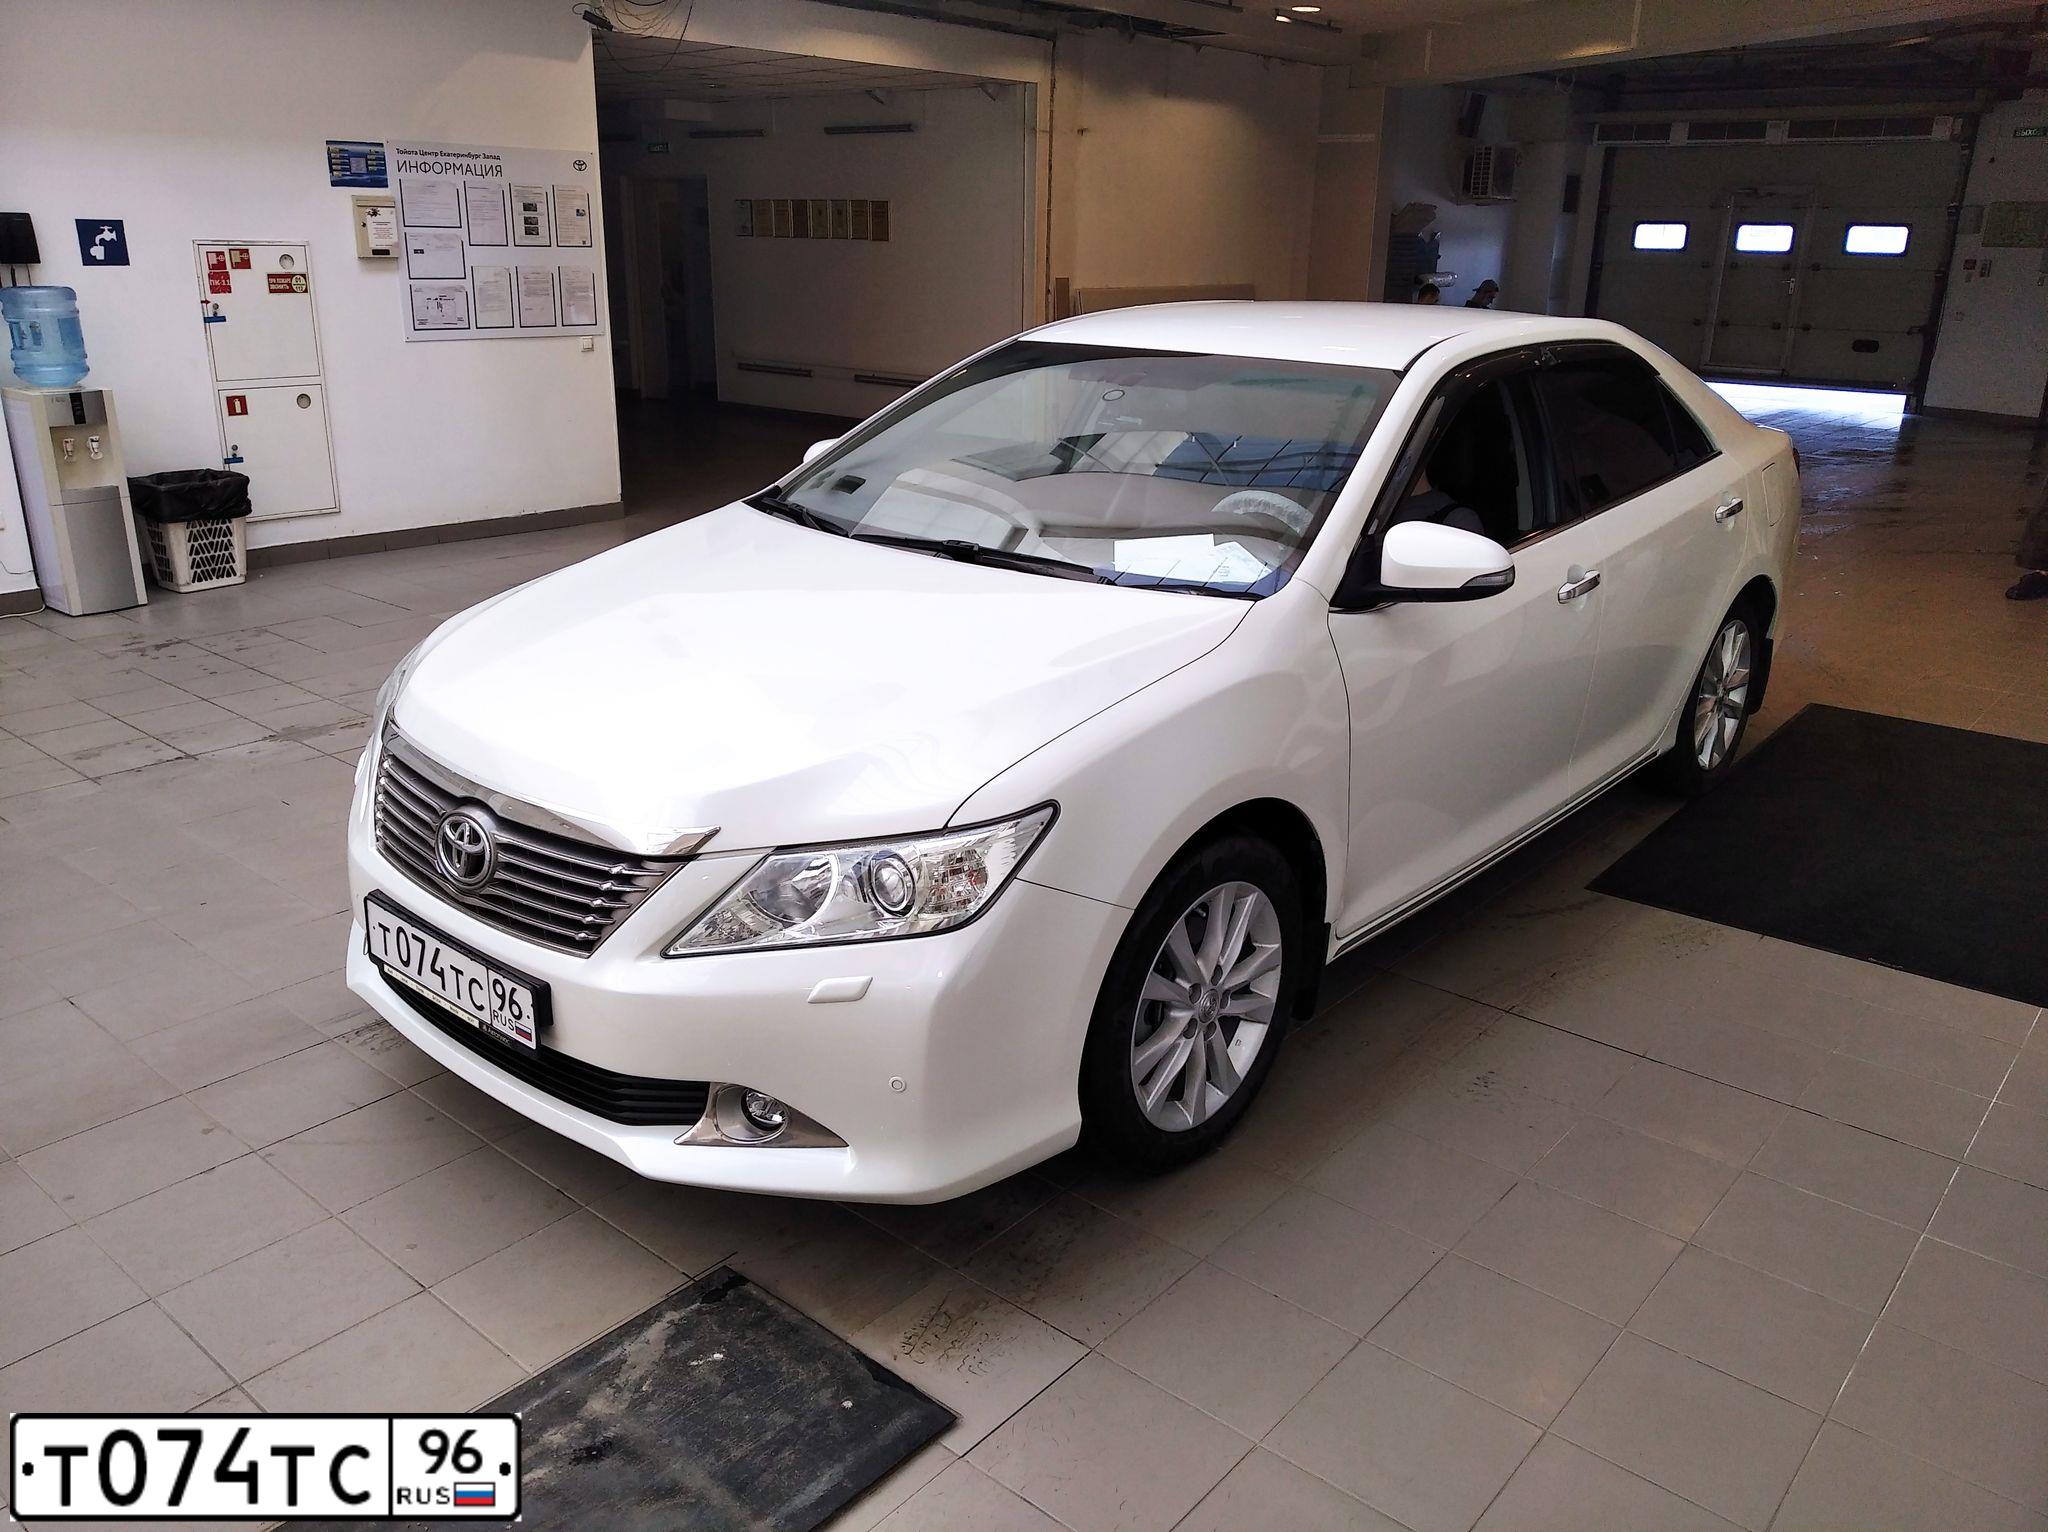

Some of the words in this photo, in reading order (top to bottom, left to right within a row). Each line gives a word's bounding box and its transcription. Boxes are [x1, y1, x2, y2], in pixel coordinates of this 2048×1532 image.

[396, 147, 418, 156] Тойота
[419, 149, 439, 158] Центр
[440, 150, 481, 160] Екатеринбург
[482, 152, 501, 161] Запад
[397, 159, 503, 179] ИНФОРМАЦИЯ
[492, 978, 523, 1020] 96
[493, 1008, 515, 1031] RUS
